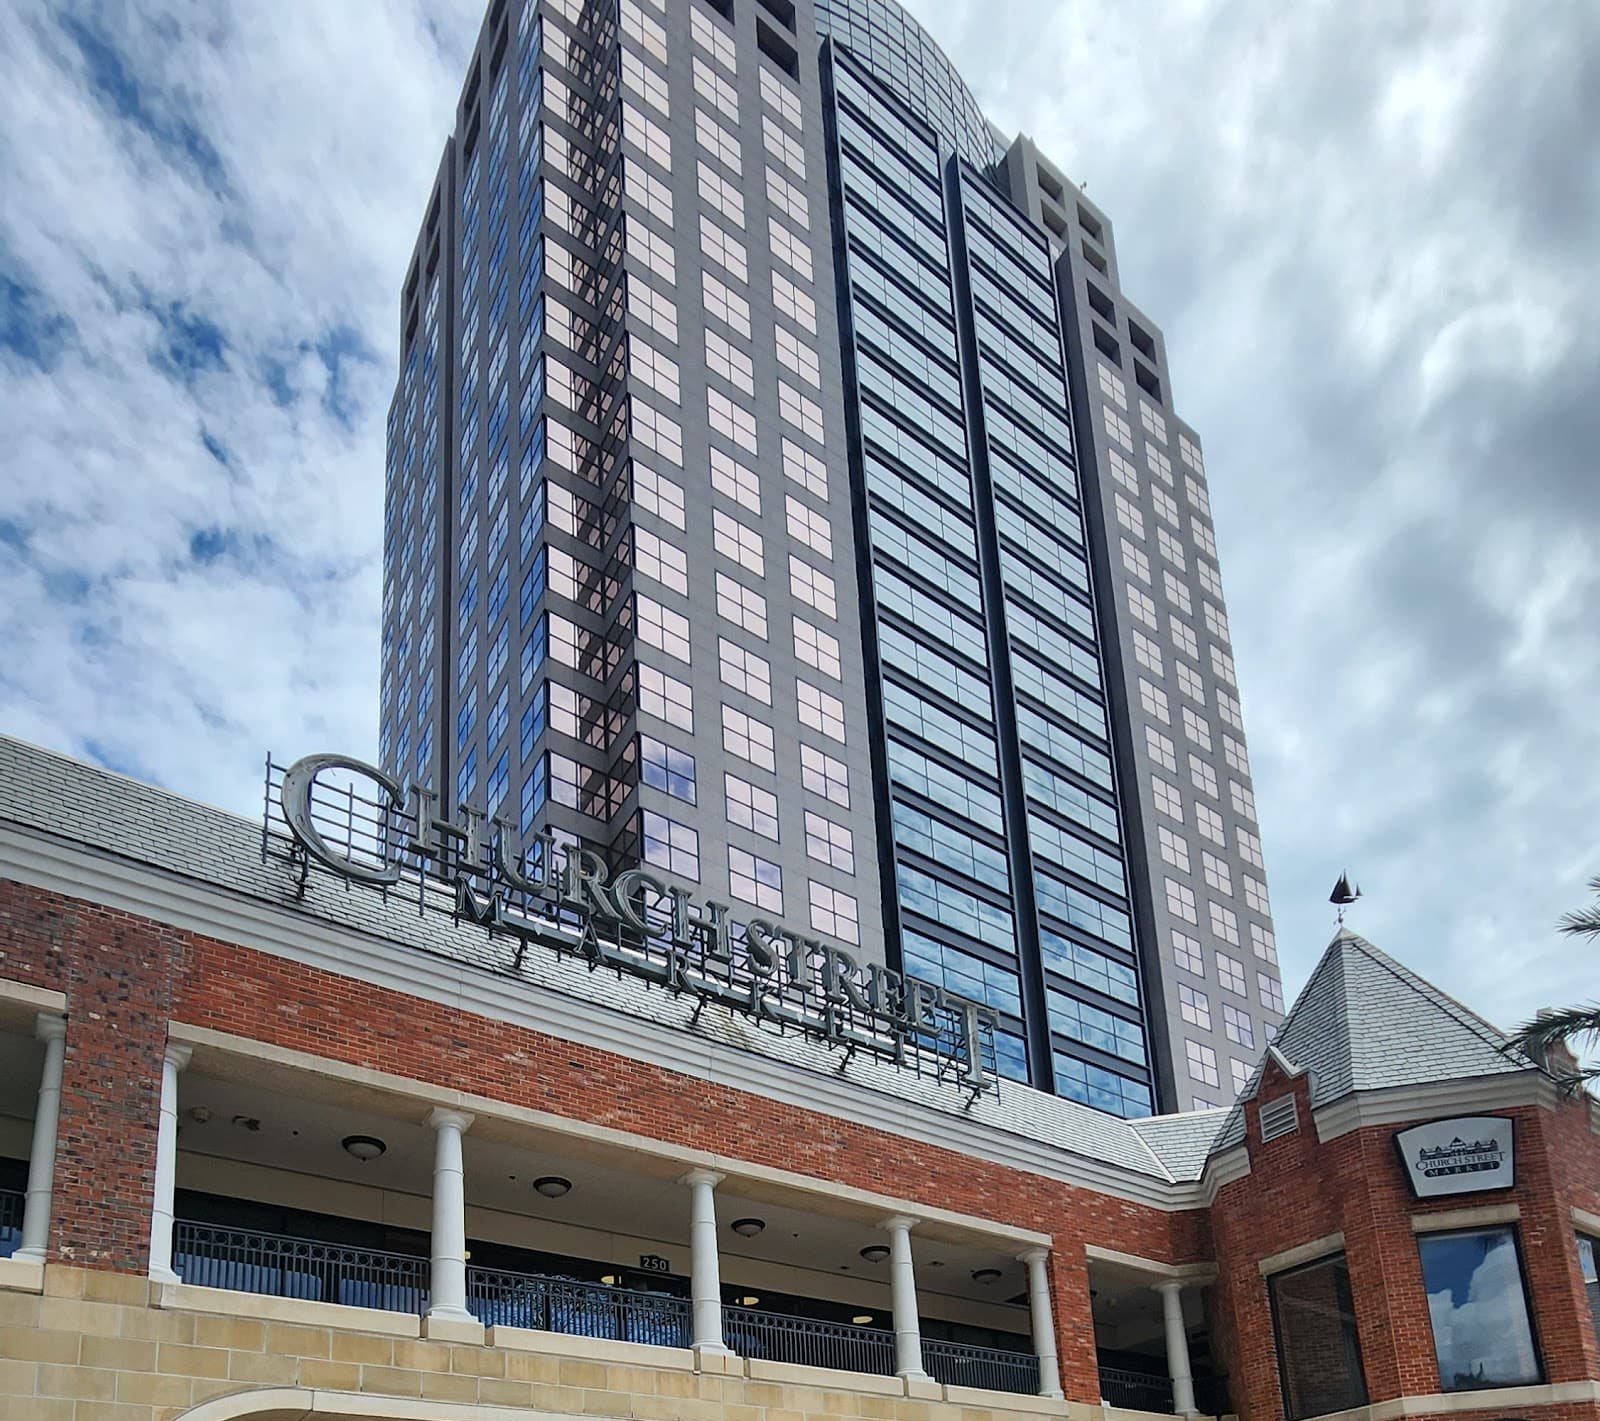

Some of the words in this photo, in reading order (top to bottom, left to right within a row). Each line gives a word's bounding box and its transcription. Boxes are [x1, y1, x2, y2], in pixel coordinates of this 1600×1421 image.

[281, 752, 732, 960] CHURCH
[747, 918, 1000, 1090] STREET
[454, 872, 911, 1066] MARKET
[1415, 1158, 1462, 1171] CHURCH
[1465, 1151, 1505, 1163] STREET
[1428, 1162, 1496, 1177] MARKET
[643, 1257, 666, 1270] 250
